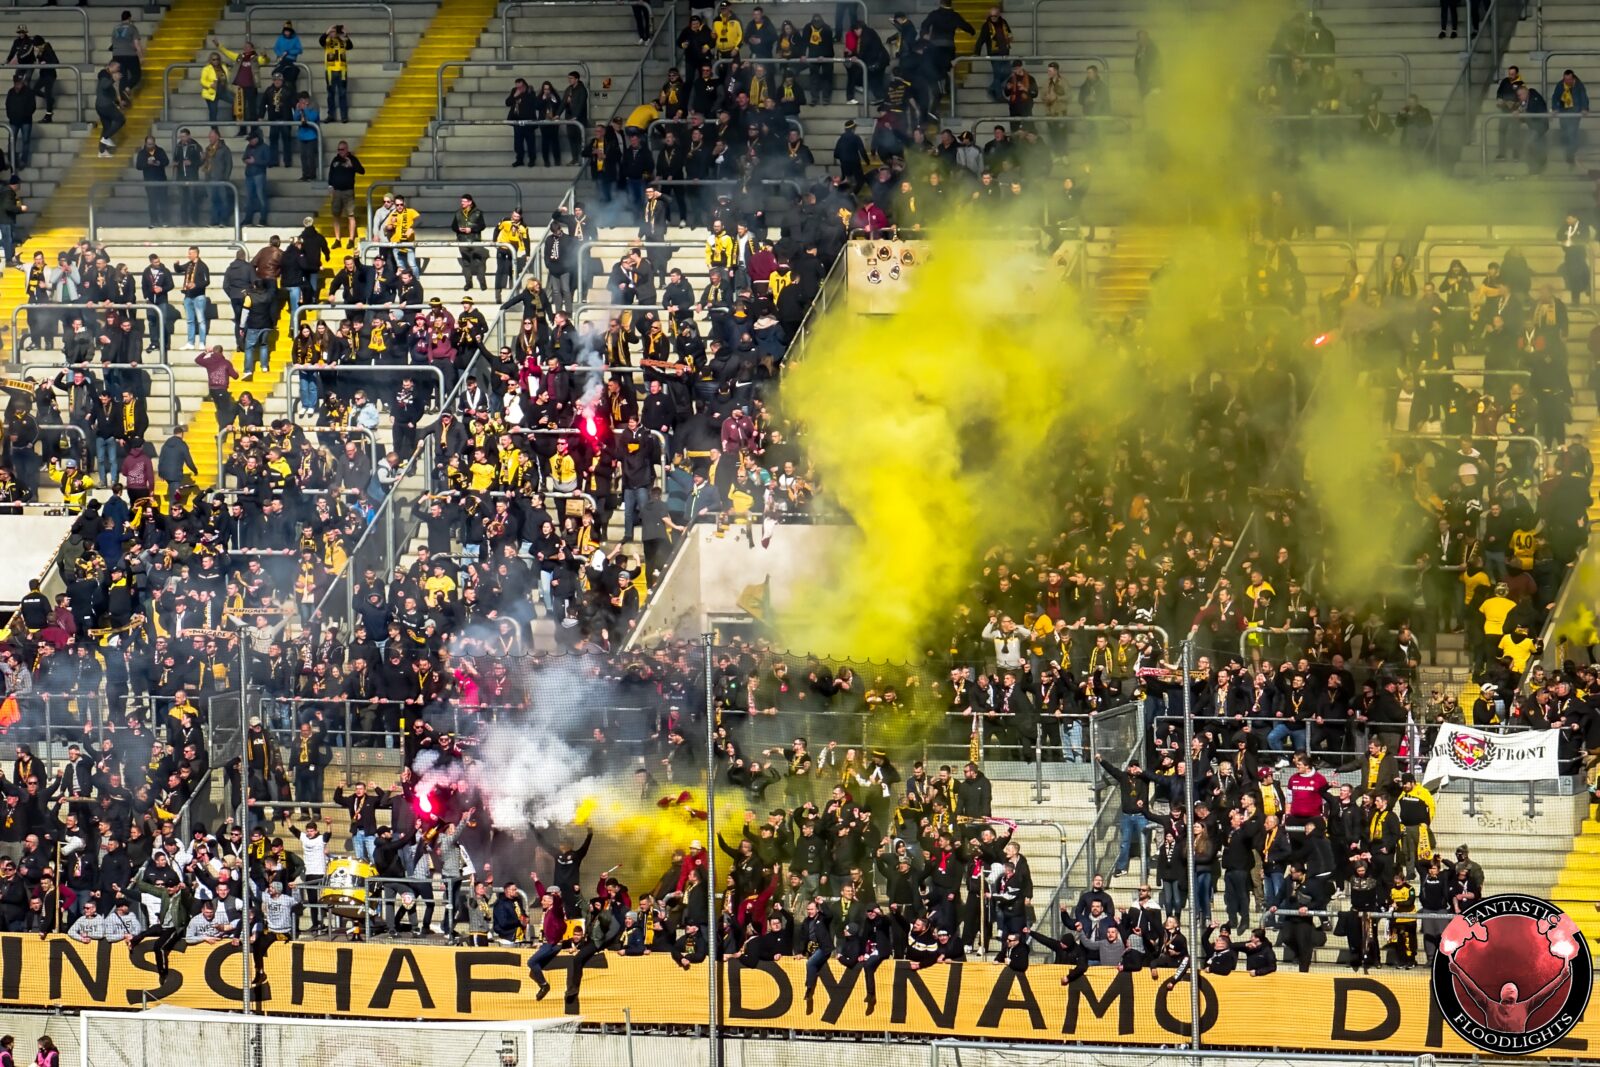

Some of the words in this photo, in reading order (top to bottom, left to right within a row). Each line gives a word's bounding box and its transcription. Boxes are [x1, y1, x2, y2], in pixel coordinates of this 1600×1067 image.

[1497, 746, 1546, 761] FRONT
[1, 935, 608, 1015] INSCHAFT
[728, 957, 1219, 1037] DYNAMO
